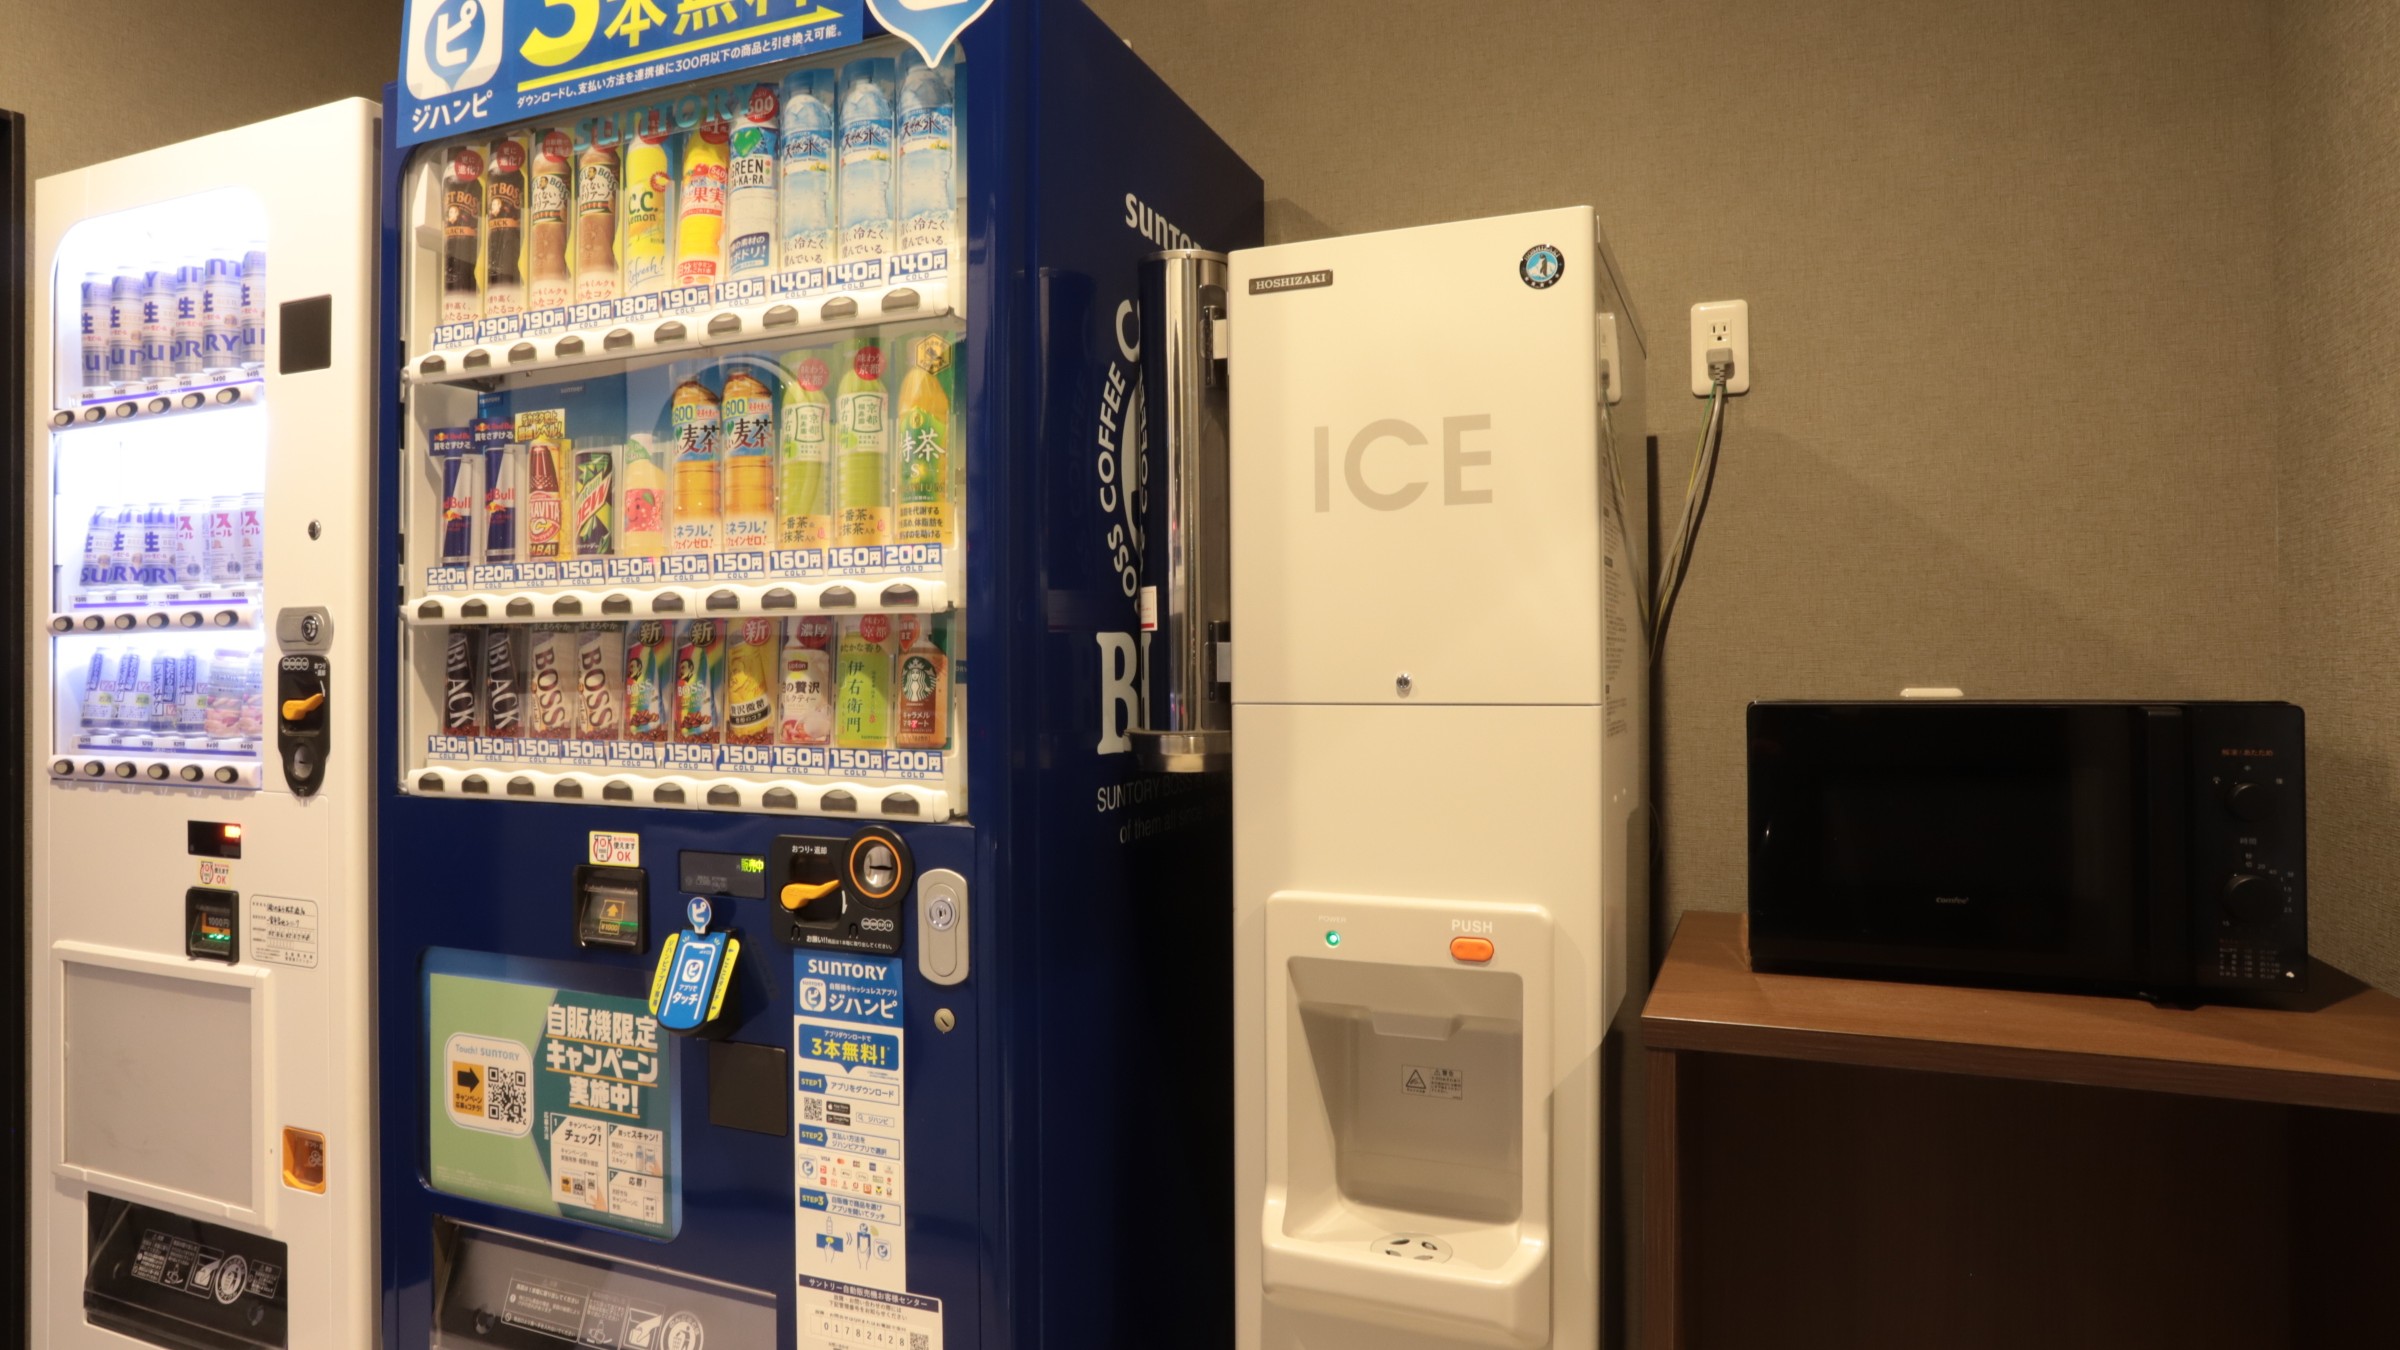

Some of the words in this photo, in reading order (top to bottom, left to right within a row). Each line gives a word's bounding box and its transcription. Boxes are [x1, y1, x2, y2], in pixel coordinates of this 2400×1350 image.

[435, 0, 478, 67] ピ
[412, 90, 494, 133] ジハンピ
[903, 117, 942, 138] 天然水
[844, 129, 881, 148] 天然水
[785, 139, 821, 158] 天然水
[629, 191, 658, 215] C.C.
[1125, 192, 1203, 250] SUNT
[828, 262, 880, 284] 140円
[891, 252, 946, 275] 140円
[717, 280, 764, 302] 180円
[772, 271, 822, 292] 140円
[1255, 273, 1327, 290] HOSHIZAKI
[178, 297, 196, 319] 生
[615, 296, 658, 316] 180円
[663, 289, 709, 311] 190円
[144, 302, 160, 324] 生
[523, 310, 563, 330] 190円
[568, 303, 610, 324] 190円
[436, 326, 474, 344] 190円
[480, 319, 518, 337] 190円
[725, 398, 745, 416] 600
[682, 424, 720, 454] 麦茶
[734, 418, 772, 449] 麦茶
[1099, 361, 1126, 513] COFFEE
[1314, 413, 1493, 514] ICE
[144, 531, 160, 552] 生
[715, 554, 763, 572] 150円
[771, 551, 821, 569] 160円
[830, 548, 881, 567] 160円
[886, 545, 941, 565] 200円
[475, 566, 513, 582] 220円
[517, 564, 556, 580] 150円
[561, 562, 603, 578] 150円
[610, 559, 652, 576] 150円
[662, 556, 707, 574] 150円
[1107, 523, 1140, 613] OSS
[428, 568, 465, 584] 220円
[640, 621, 661, 643] 新
[691, 621, 712, 643] 新
[745, 617, 768, 642] 新
[799, 623, 829, 638] 濃厚
[448, 637, 476, 728] BLACK
[489, 637, 520, 730] BLACK
[535, 646, 567, 728] BOSS
[581, 646, 613, 728] BOSS
[626, 680, 655, 696] BOSS
[677, 680, 706, 697] BOSS
[847, 660, 865, 733] 伊右衛門
[430, 737, 466, 752] 150円
[475, 738, 512, 754] 150円
[519, 740, 558, 756] 150円
[562, 741, 604, 757] 150円
[611, 743, 653, 759] 150円
[667, 744, 711, 762] 150円
[722, 746, 768, 764] 150円
[774, 749, 823, 767] 160円
[830, 750, 882, 769] 150円
[887, 752, 941, 771] 200円
[617, 851, 631, 862] OK
[792, 845, 828, 855] おつり・返却
[216, 874, 227, 885] OK
[691, 901, 707, 923] ピ
[1451, 919, 1493, 934] PUSH
[808, 959, 887, 981] SUNTORY
[672, 991, 699, 1006] タッチ
[829, 993, 898, 1019] ジハンピ
[547, 1004, 658, 1050] 自販機限定
[824, 1030, 872, 1042] アプリダウンロードで
[480, 1047, 520, 1061] SUNTORY
[546, 1039, 659, 1083] キャンペーン
[811, 1037, 887, 1066] 3本無料!
[801, 1078, 822, 1089] STEP1
[831, 1081, 895, 1099] アプリをダウンロード
[569, 1076, 640, 1116] 実施中!
[565, 1129, 602, 1147] チェック!
[802, 1131, 824, 1142] STEP2
[802, 1194, 825, 1206] STEP3
[809, 1278, 928, 1307] サントリー自動販売機お客様センター
